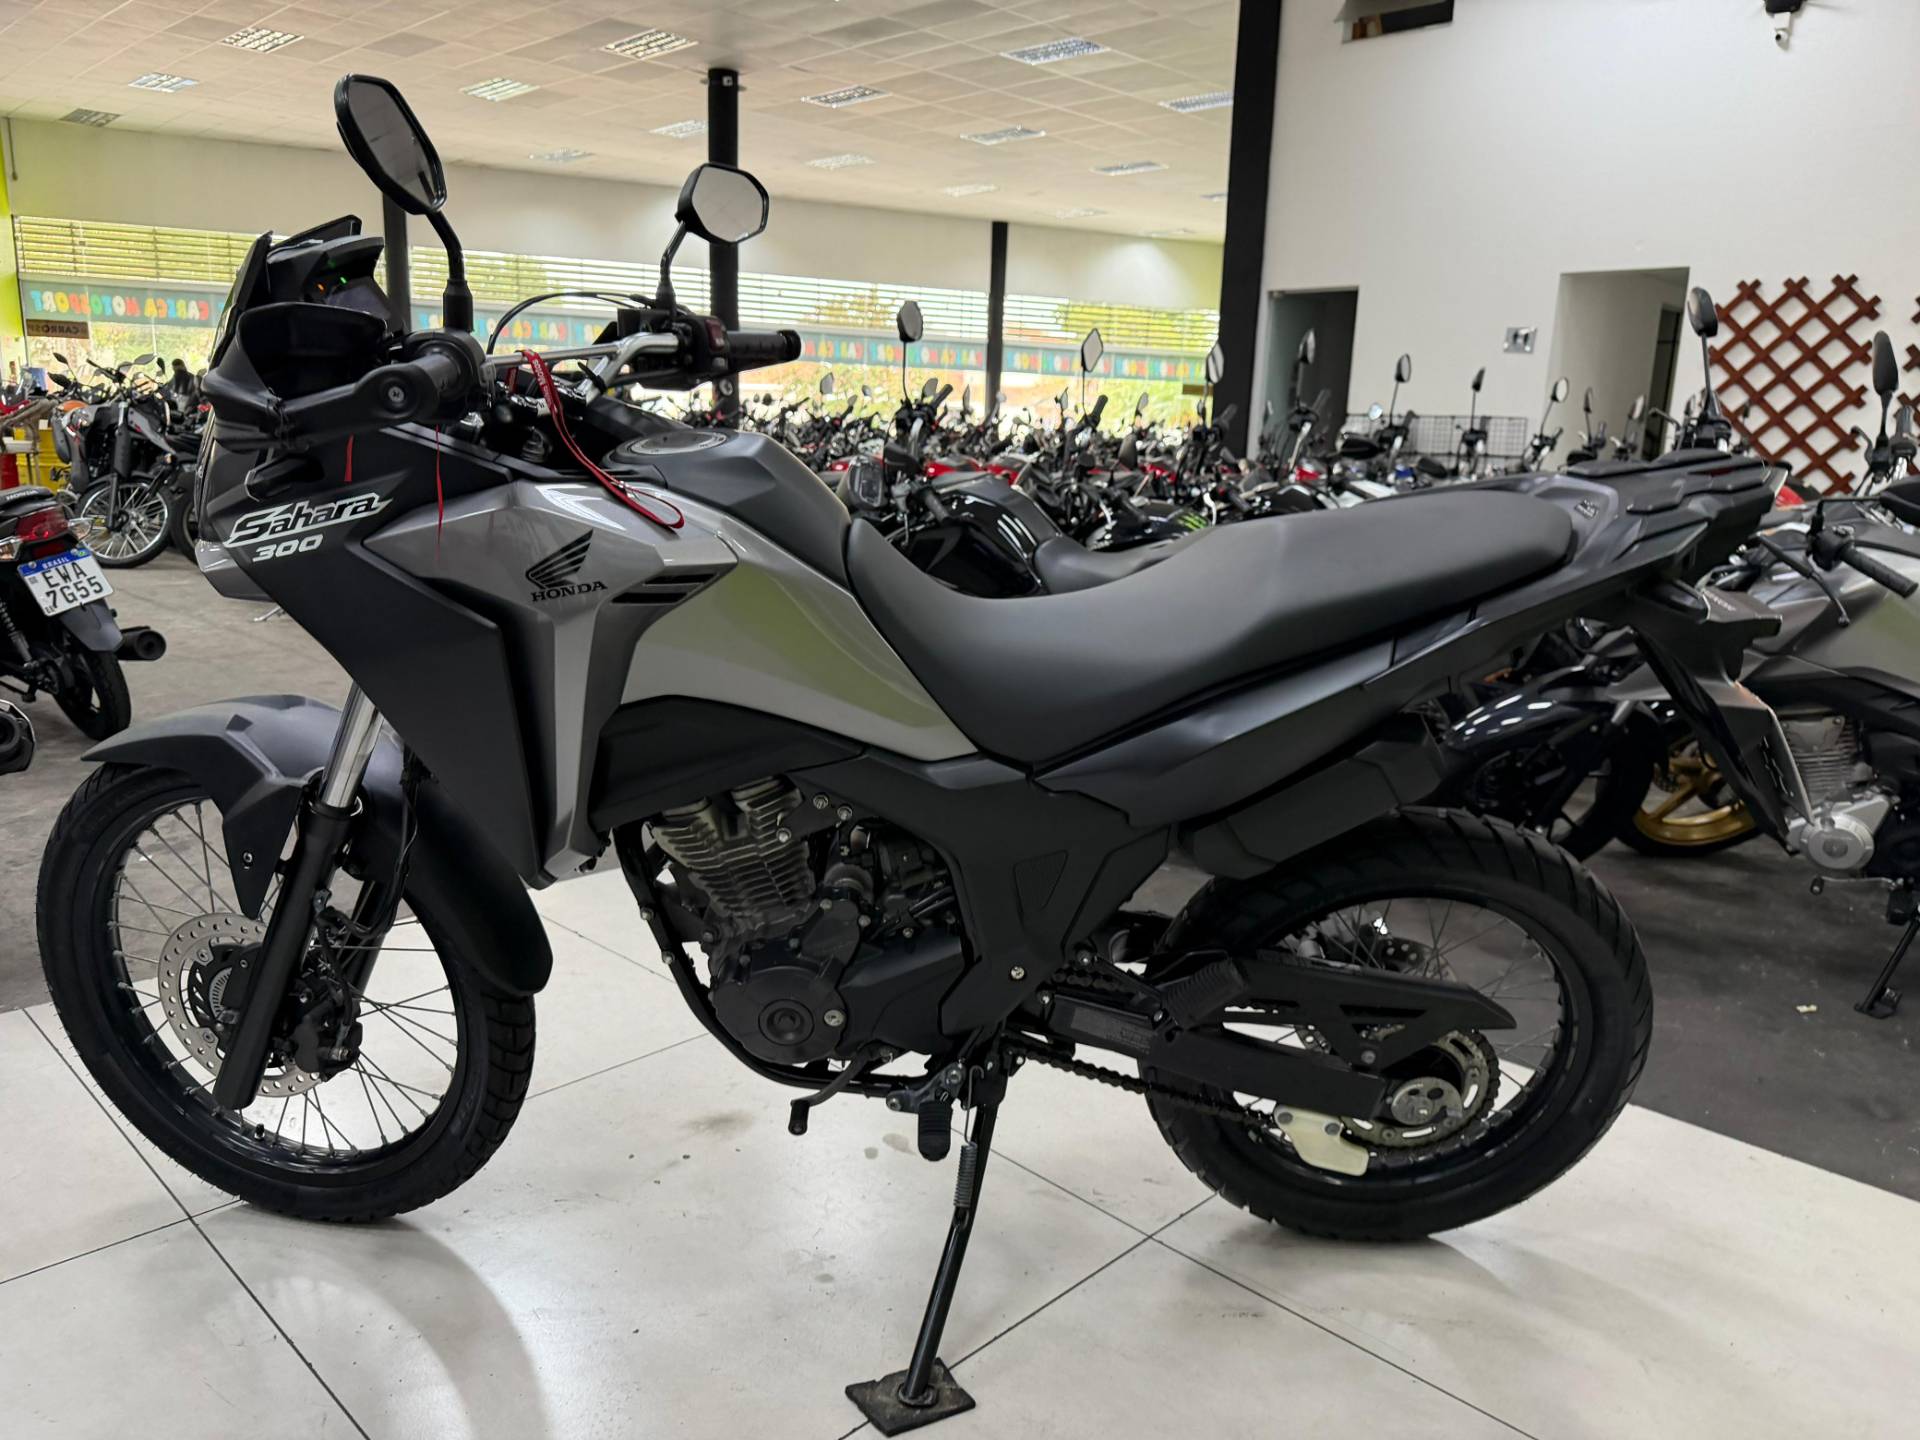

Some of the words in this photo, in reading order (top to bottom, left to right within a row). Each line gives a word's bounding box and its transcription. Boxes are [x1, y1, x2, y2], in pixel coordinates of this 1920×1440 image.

[222, 492, 393, 548] Sahara
[252, 533, 323, 562] 300
[41, 556, 70, 569] BRASIL
[41, 561, 87, 588] EWA
[45, 575, 104, 609] 7G55
[530, 581, 608, 602] HONDA
